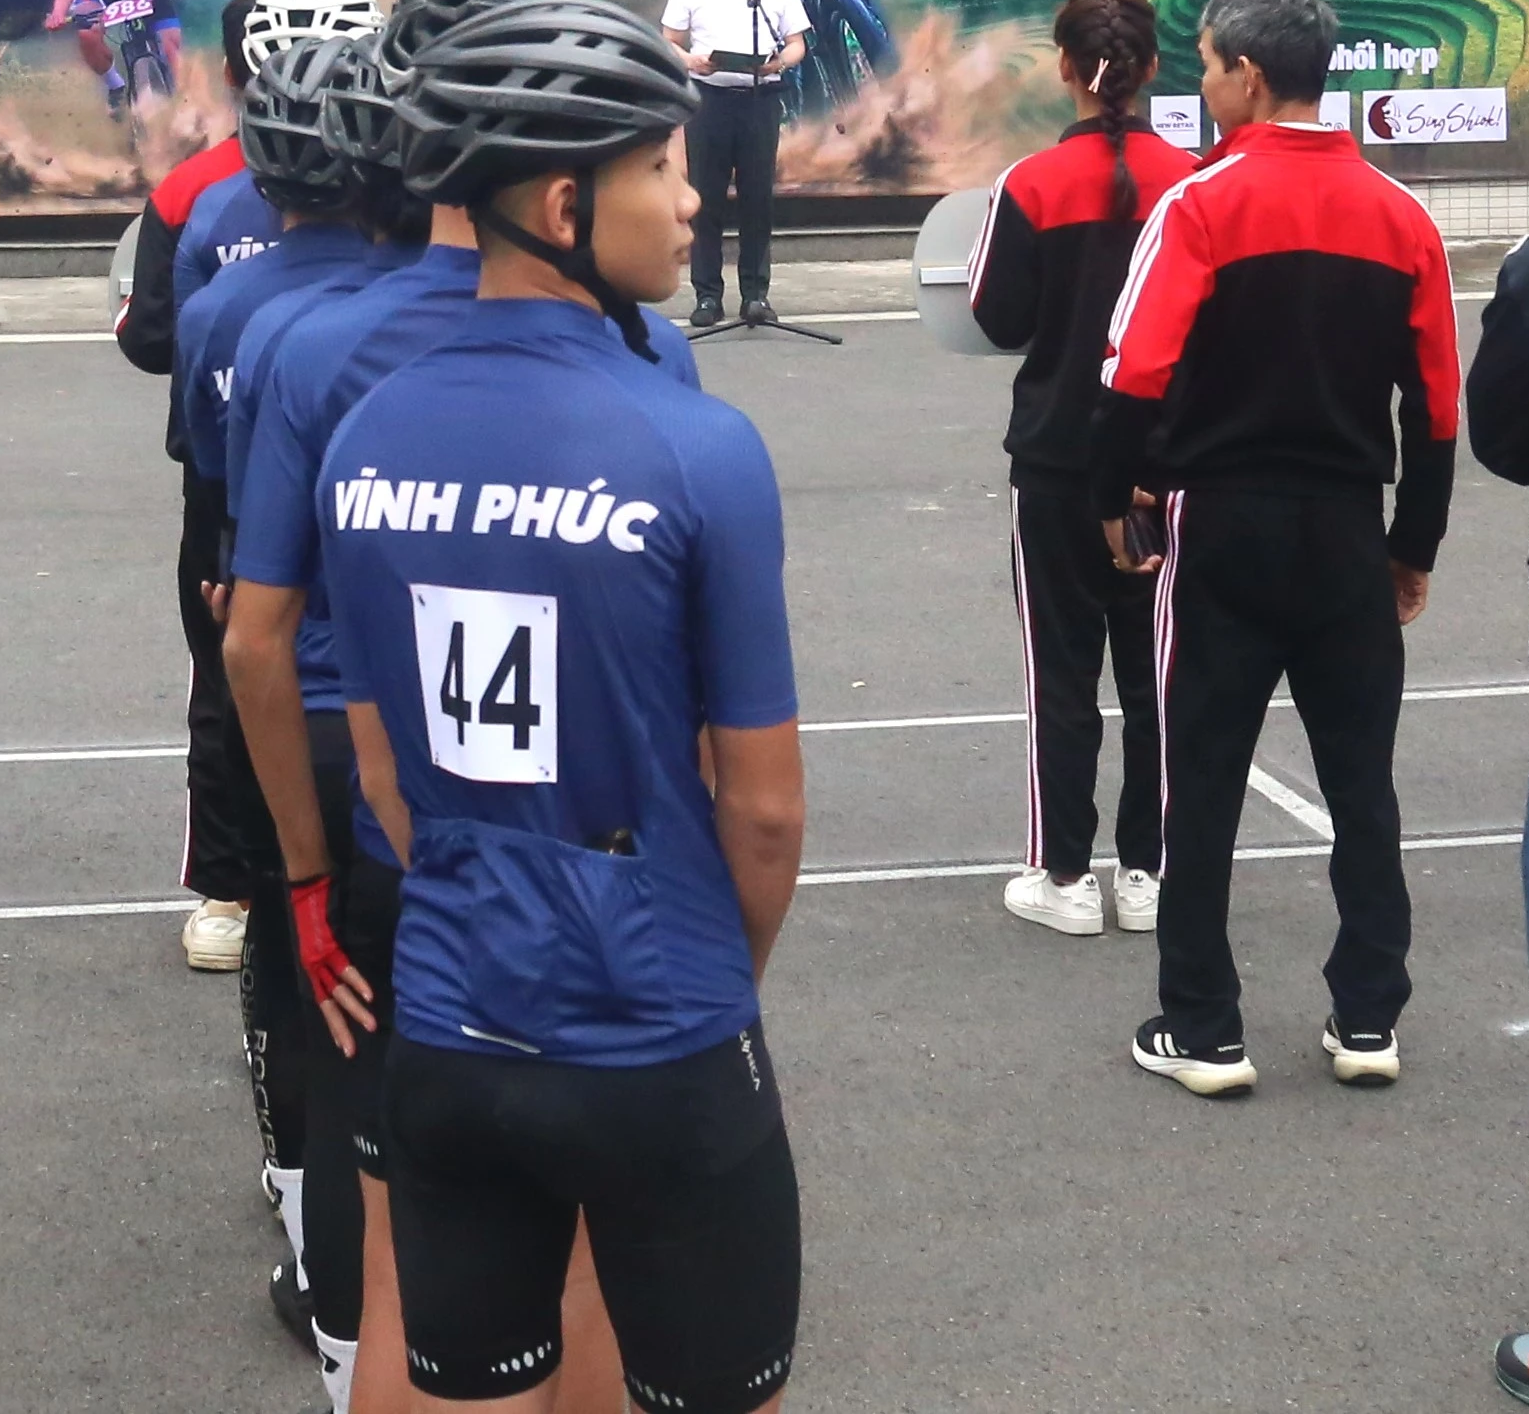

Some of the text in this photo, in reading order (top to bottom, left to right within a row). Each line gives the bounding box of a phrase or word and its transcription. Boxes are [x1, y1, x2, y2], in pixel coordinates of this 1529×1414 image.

[1383, 43, 1439, 75] hợp
[335, 468, 659, 553] VĨNH PHÚC
[440, 620, 541, 750] 44
